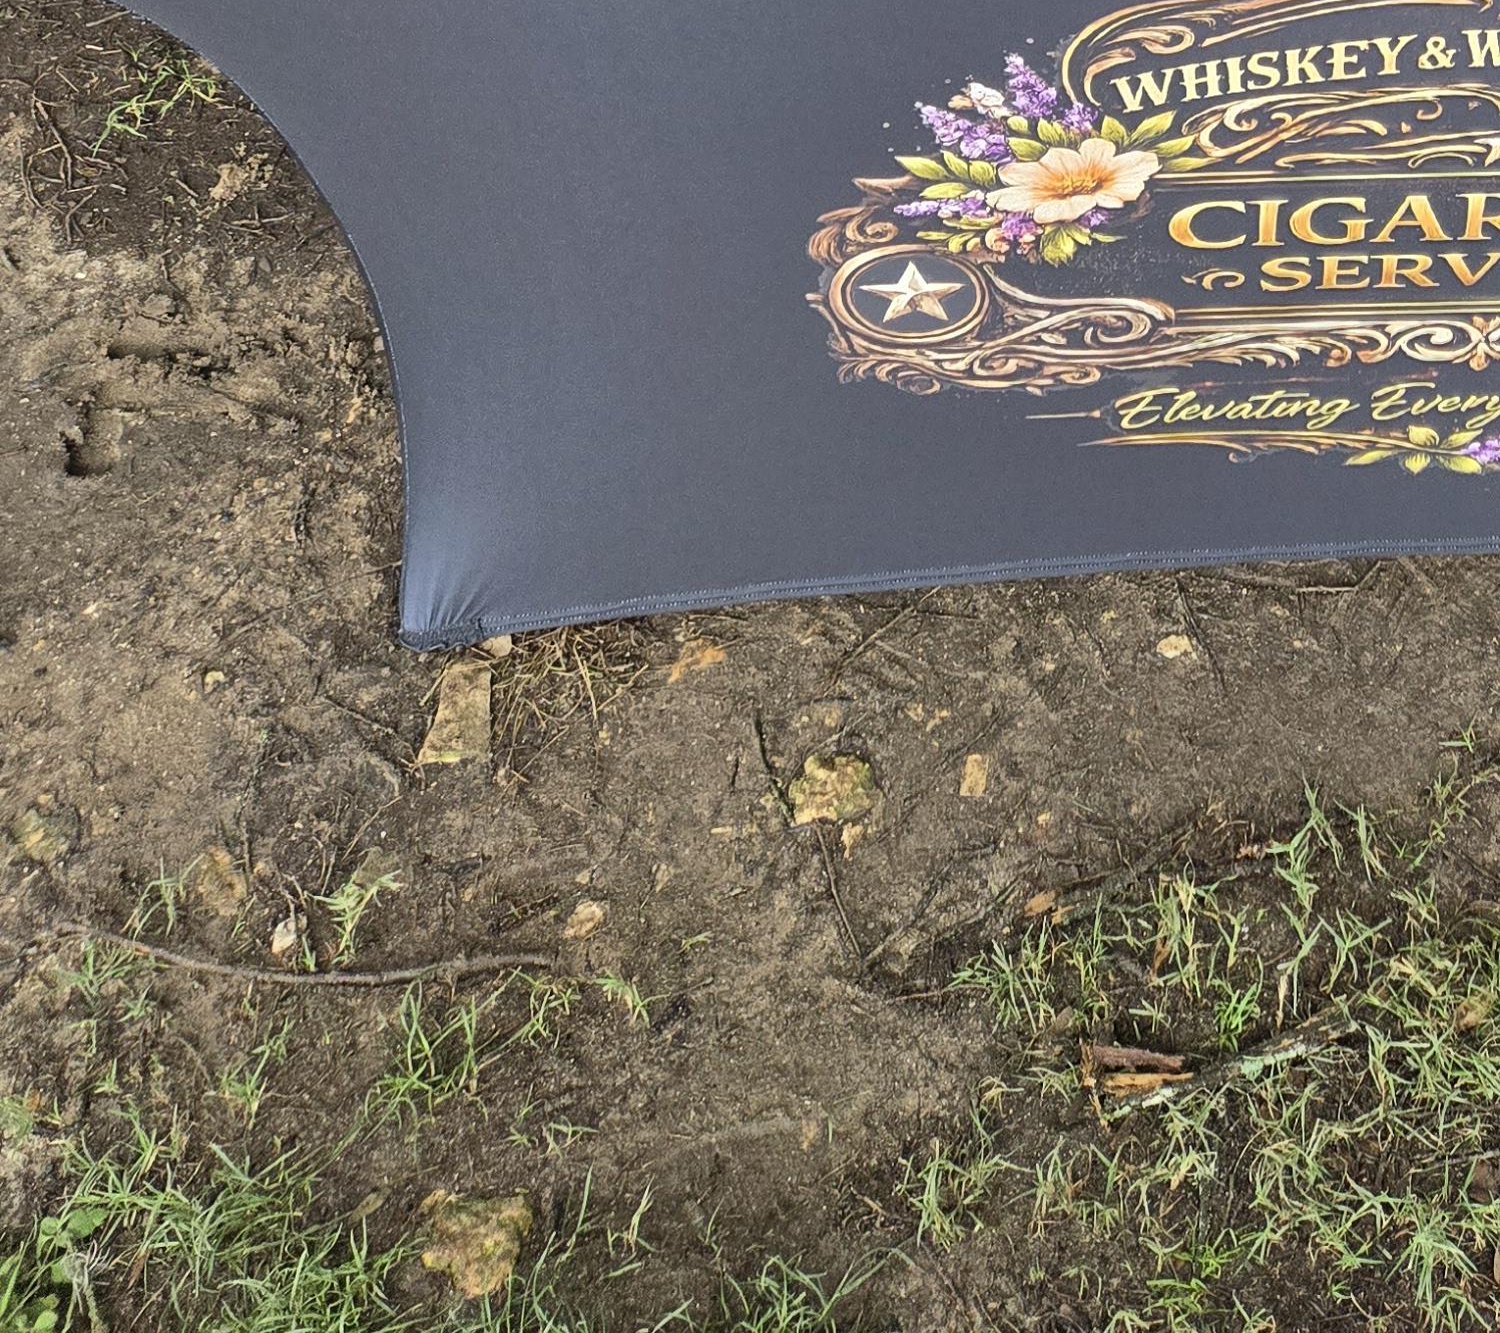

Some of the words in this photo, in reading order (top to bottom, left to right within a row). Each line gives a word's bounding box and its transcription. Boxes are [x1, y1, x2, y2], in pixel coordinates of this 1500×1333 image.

[1109, 34, 1419, 114] WHISKEY
[1418, 35, 1457, 71] &
[1114, 388, 1357, 432] Elevating
